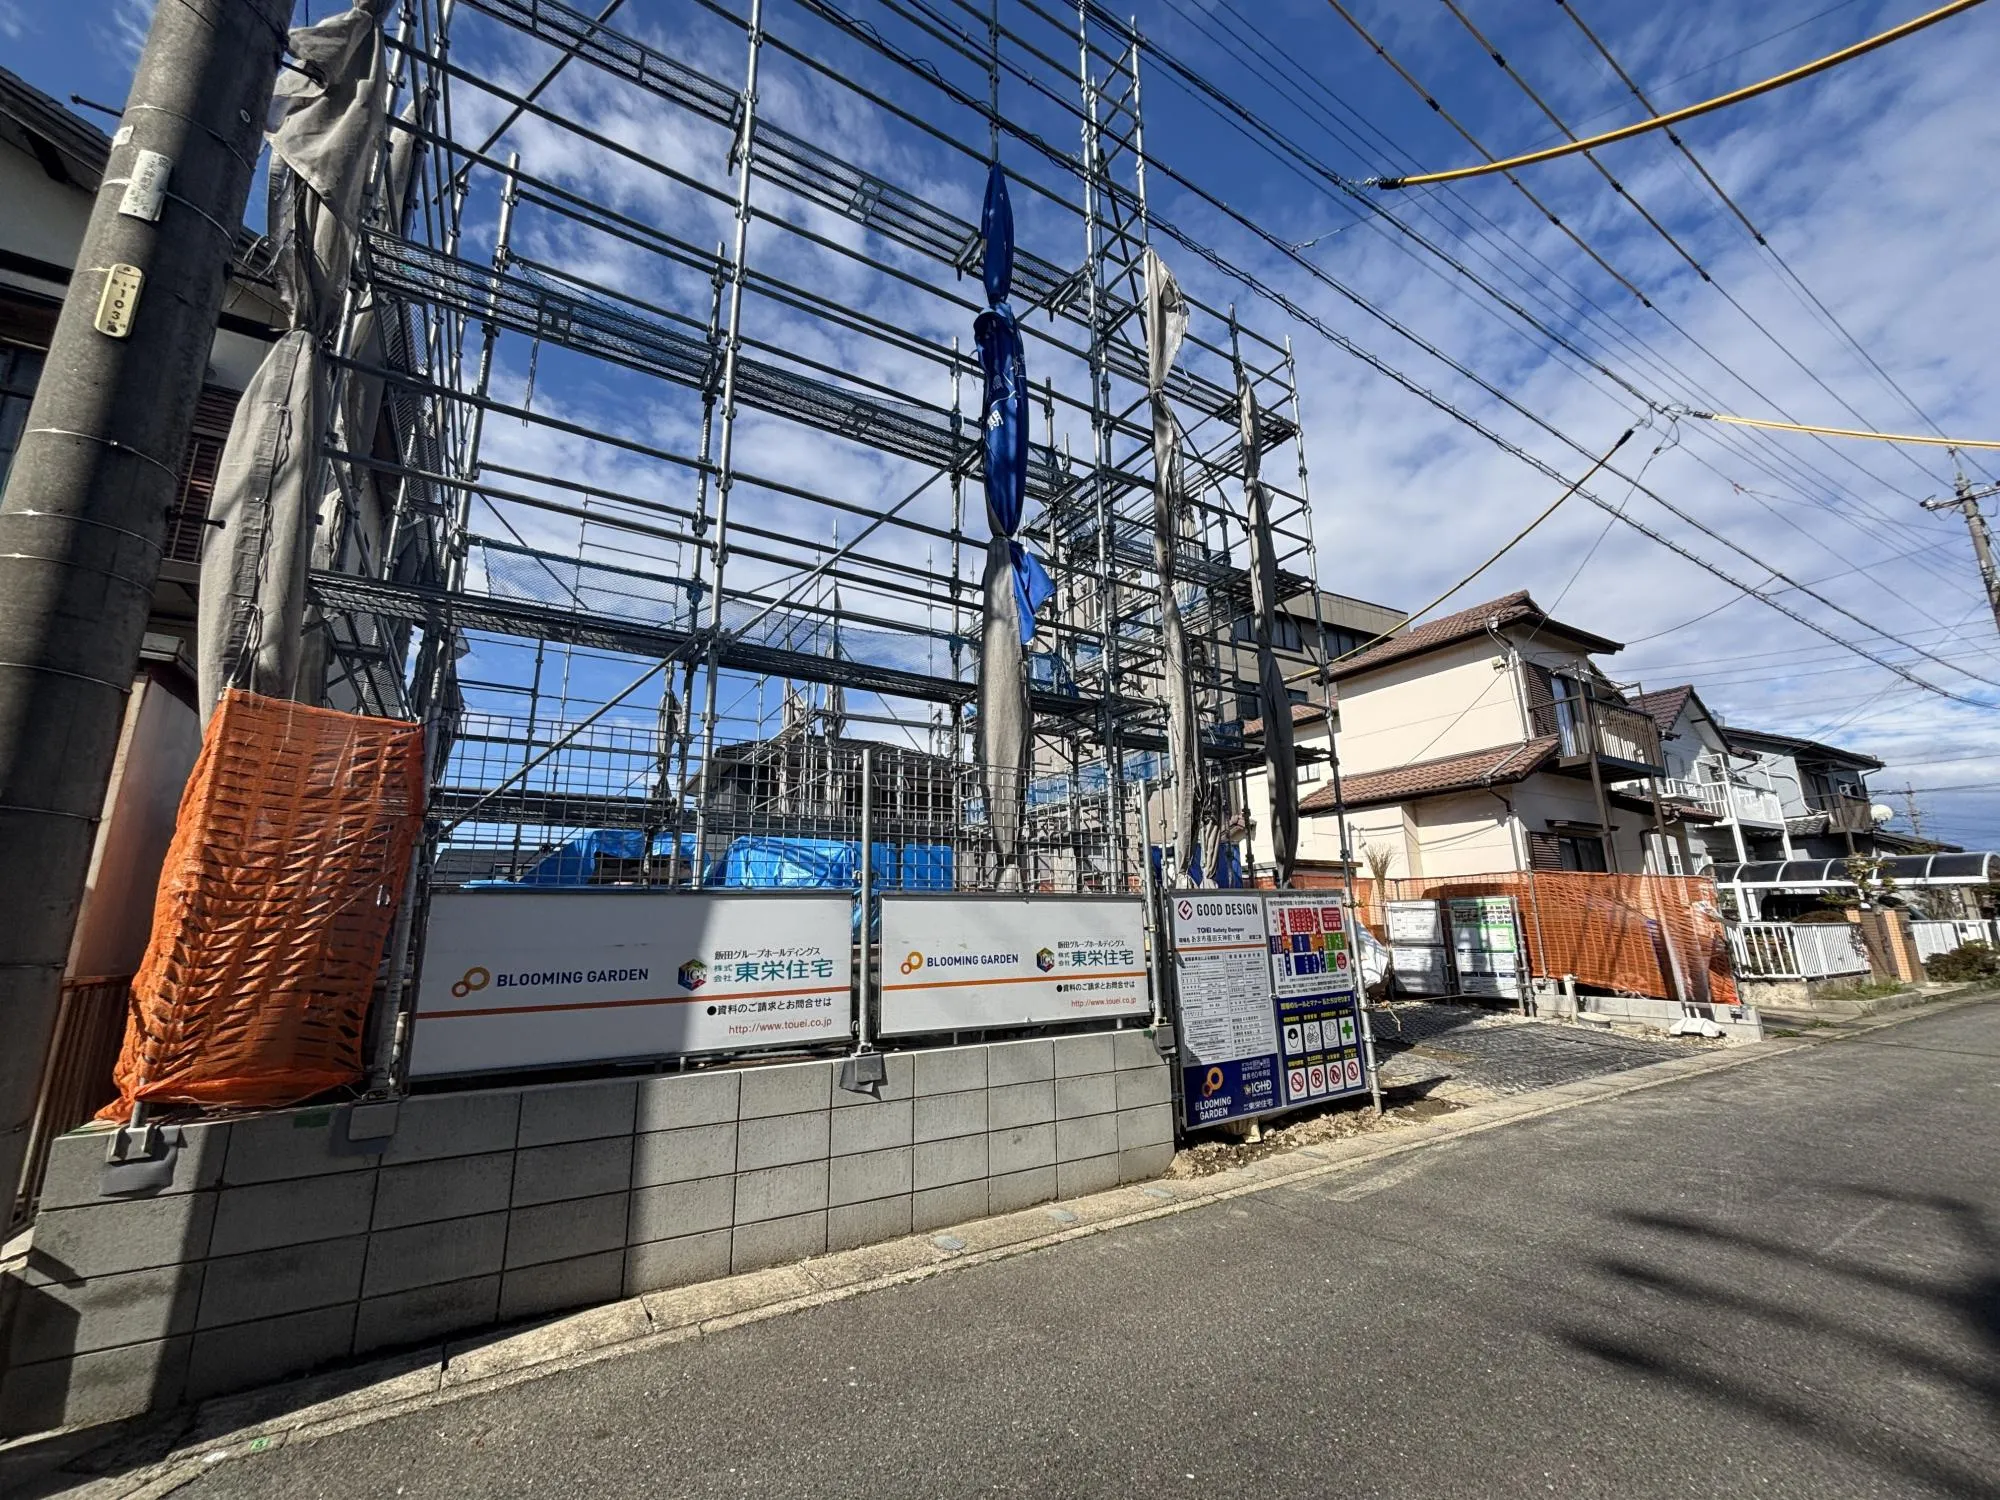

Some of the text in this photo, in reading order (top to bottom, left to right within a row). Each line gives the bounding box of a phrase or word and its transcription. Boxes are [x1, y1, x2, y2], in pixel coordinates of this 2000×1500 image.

[1196, 903, 1258, 916] GOOD DESIGN
[714, 947, 821, 961] 飯田グループホールディングス
[927, 954, 1019, 967] BLOOMING GARDEN
[1071, 949, 1134, 967] 東栄住宅
[497, 968, 649, 988] BLOOMING GARDEN
[734, 958, 833, 983] 東栄住宅
[728, 1017, 832, 1035] http://www.touei.co.jp
[1195, 1096, 1232, 1111] BLOOMING
[1199, 1107, 1228, 1120] GARDEN
